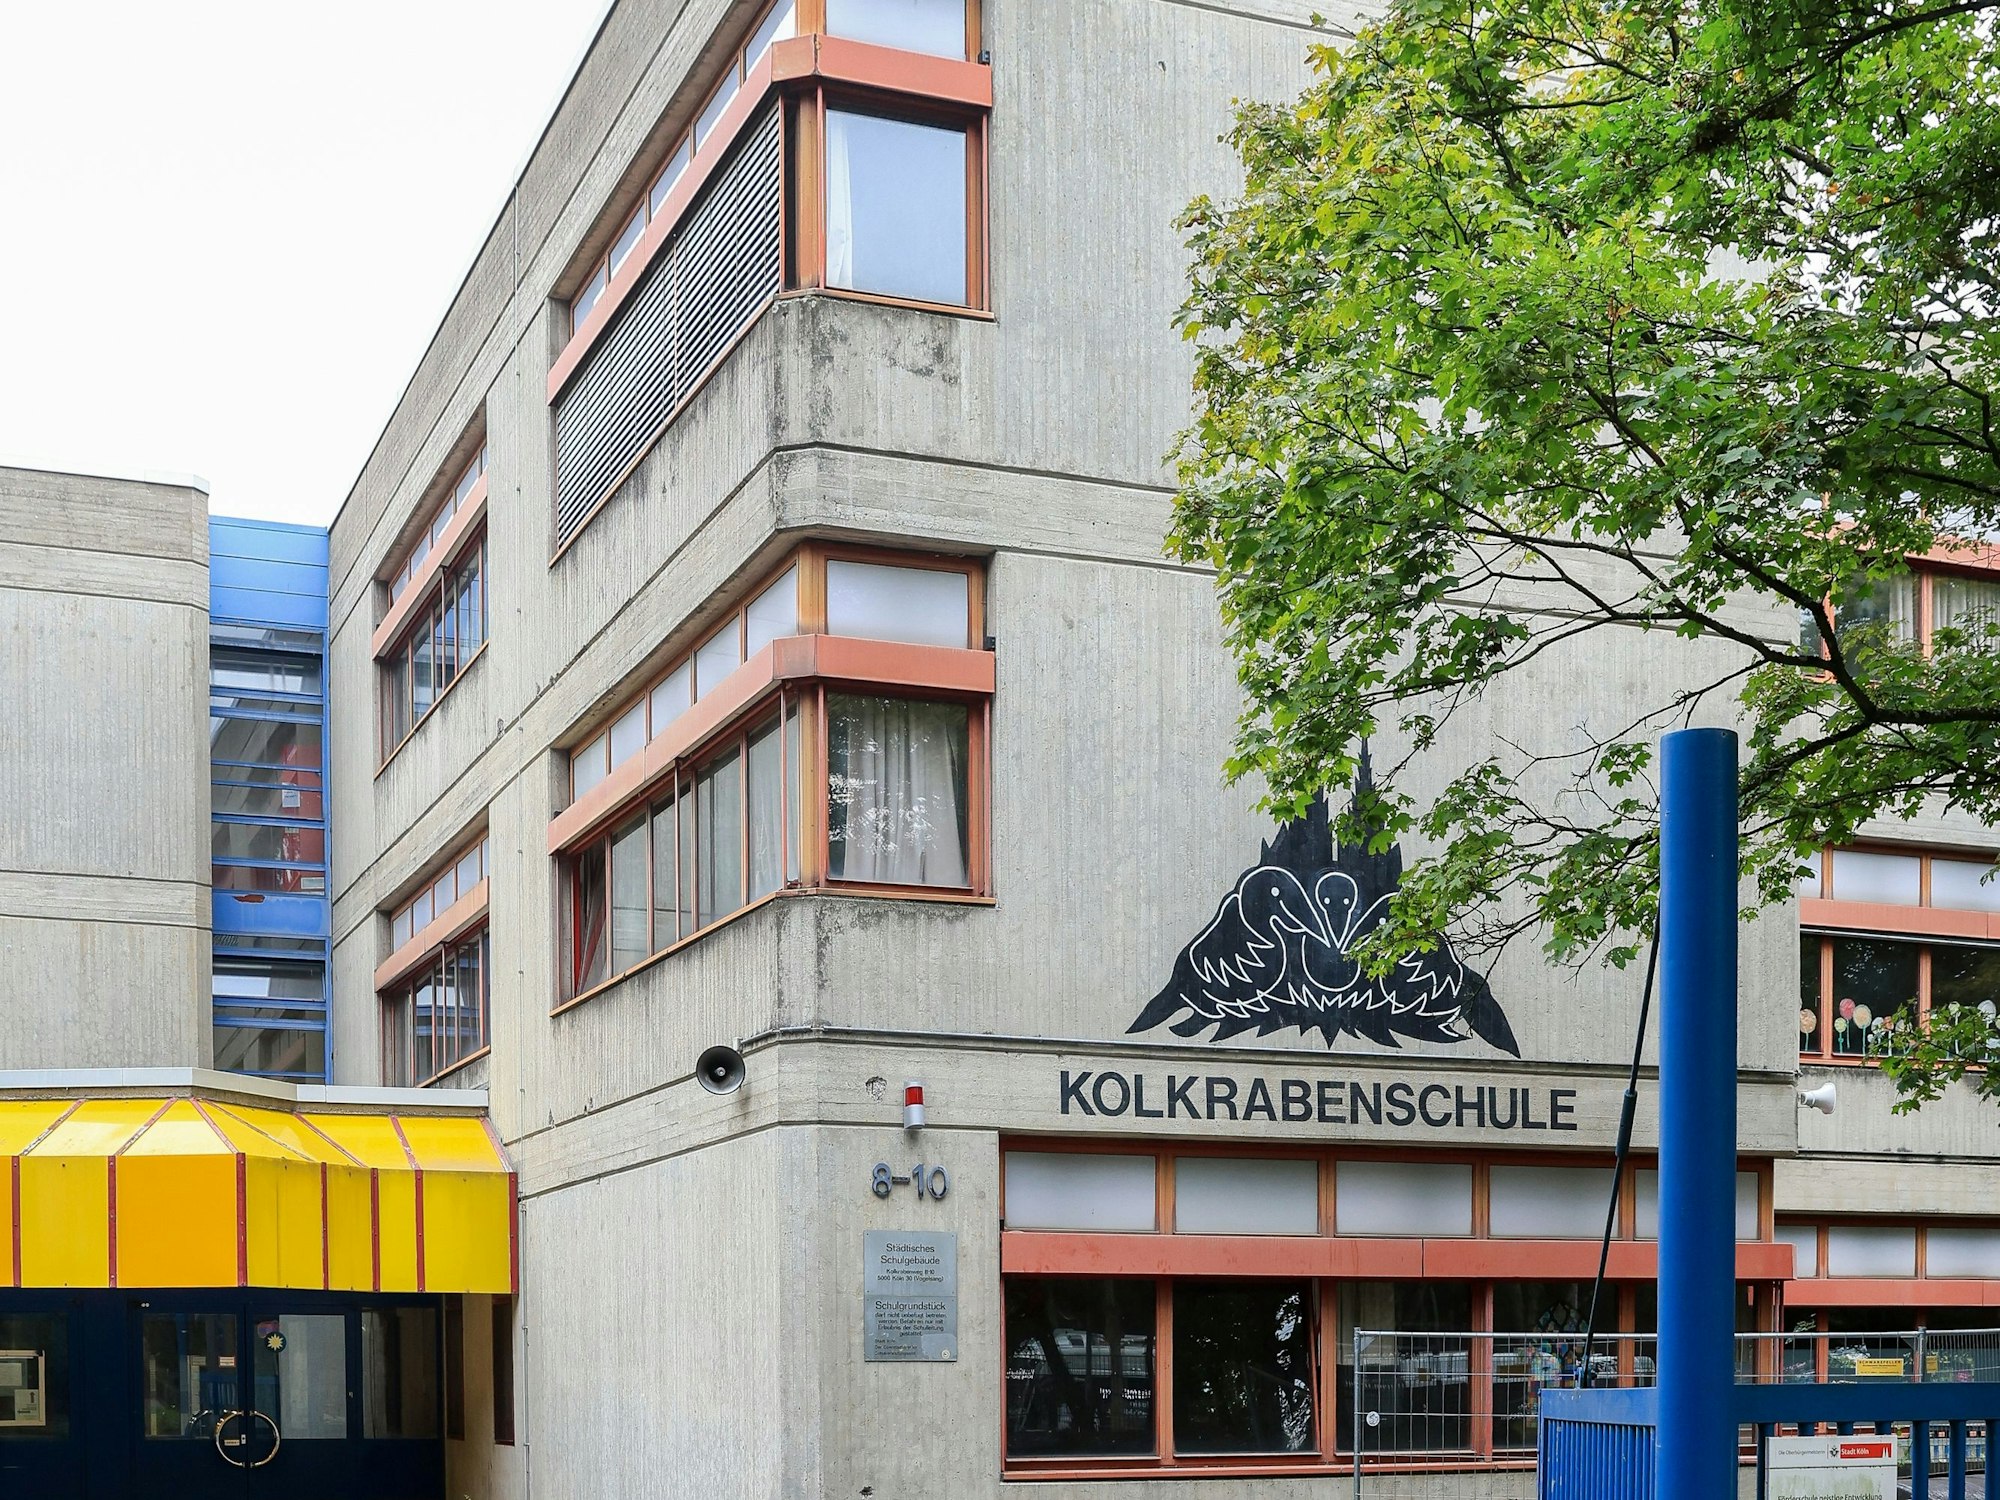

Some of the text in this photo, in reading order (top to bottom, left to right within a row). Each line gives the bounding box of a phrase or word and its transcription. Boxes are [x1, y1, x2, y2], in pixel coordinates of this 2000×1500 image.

[1060, 1070, 1577, 1131] KOLKRABENSCHULE
[872, 1161, 949, 1201] 8-10
[886, 1243, 934, 1252] Städtisches
[880, 1255, 940, 1266] Schulgebäude
[875, 1300, 946, 1311] Schulgrundstück
[1841, 1447, 1870, 1455] Stadt Köln
